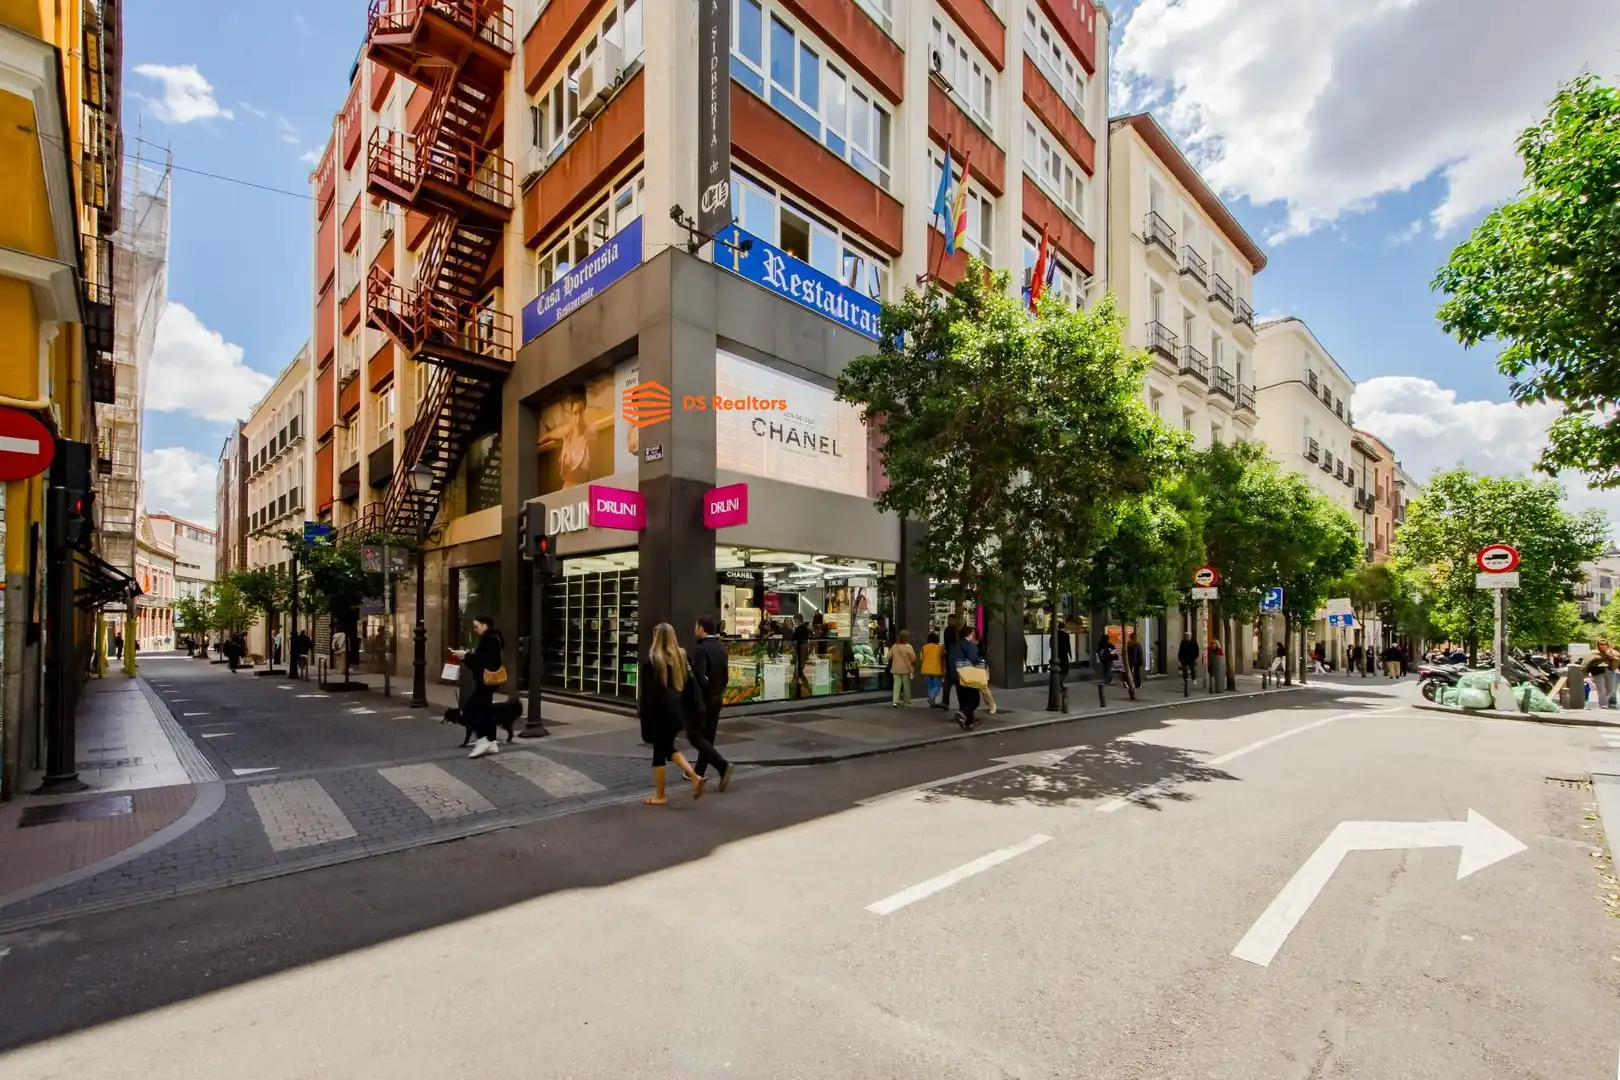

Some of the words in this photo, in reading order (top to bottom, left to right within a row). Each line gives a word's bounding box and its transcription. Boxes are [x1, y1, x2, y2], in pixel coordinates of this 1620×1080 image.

[709, 160, 719, 173] de
[536, 288, 561, 316] Casa
[562, 243, 619, 300] Hortensia
[556, 287, 594, 320] Restaurante
[762, 248, 884, 338] Restauran
[751, 417, 843, 458] CHANEL
[549, 501, 589, 536] DRUN
[597, 499, 636, 516] DRUNI
[711, 498, 739, 515] DRUNI
[726, 571, 754, 579] CHANEL
[1265, 591, 1278, 605] P
